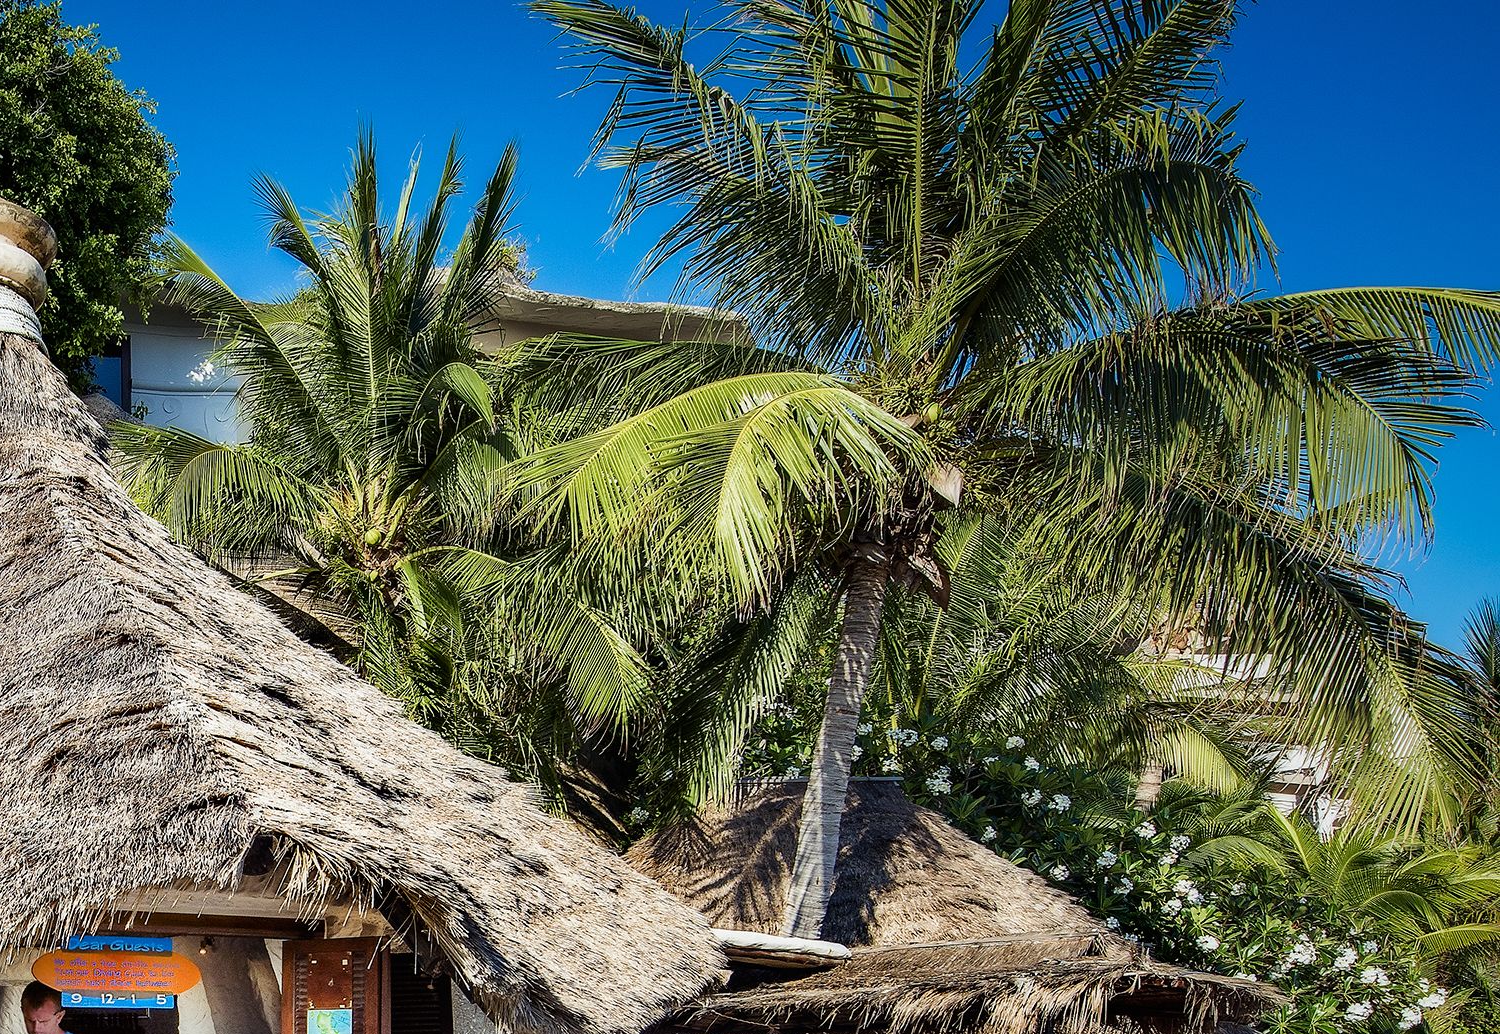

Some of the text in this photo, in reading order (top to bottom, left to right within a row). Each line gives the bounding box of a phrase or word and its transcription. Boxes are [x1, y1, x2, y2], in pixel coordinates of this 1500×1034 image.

[110, 940, 164, 952] Guests
[70, 993, 82, 1004] 9
[156, 994, 167, 1005] 5
